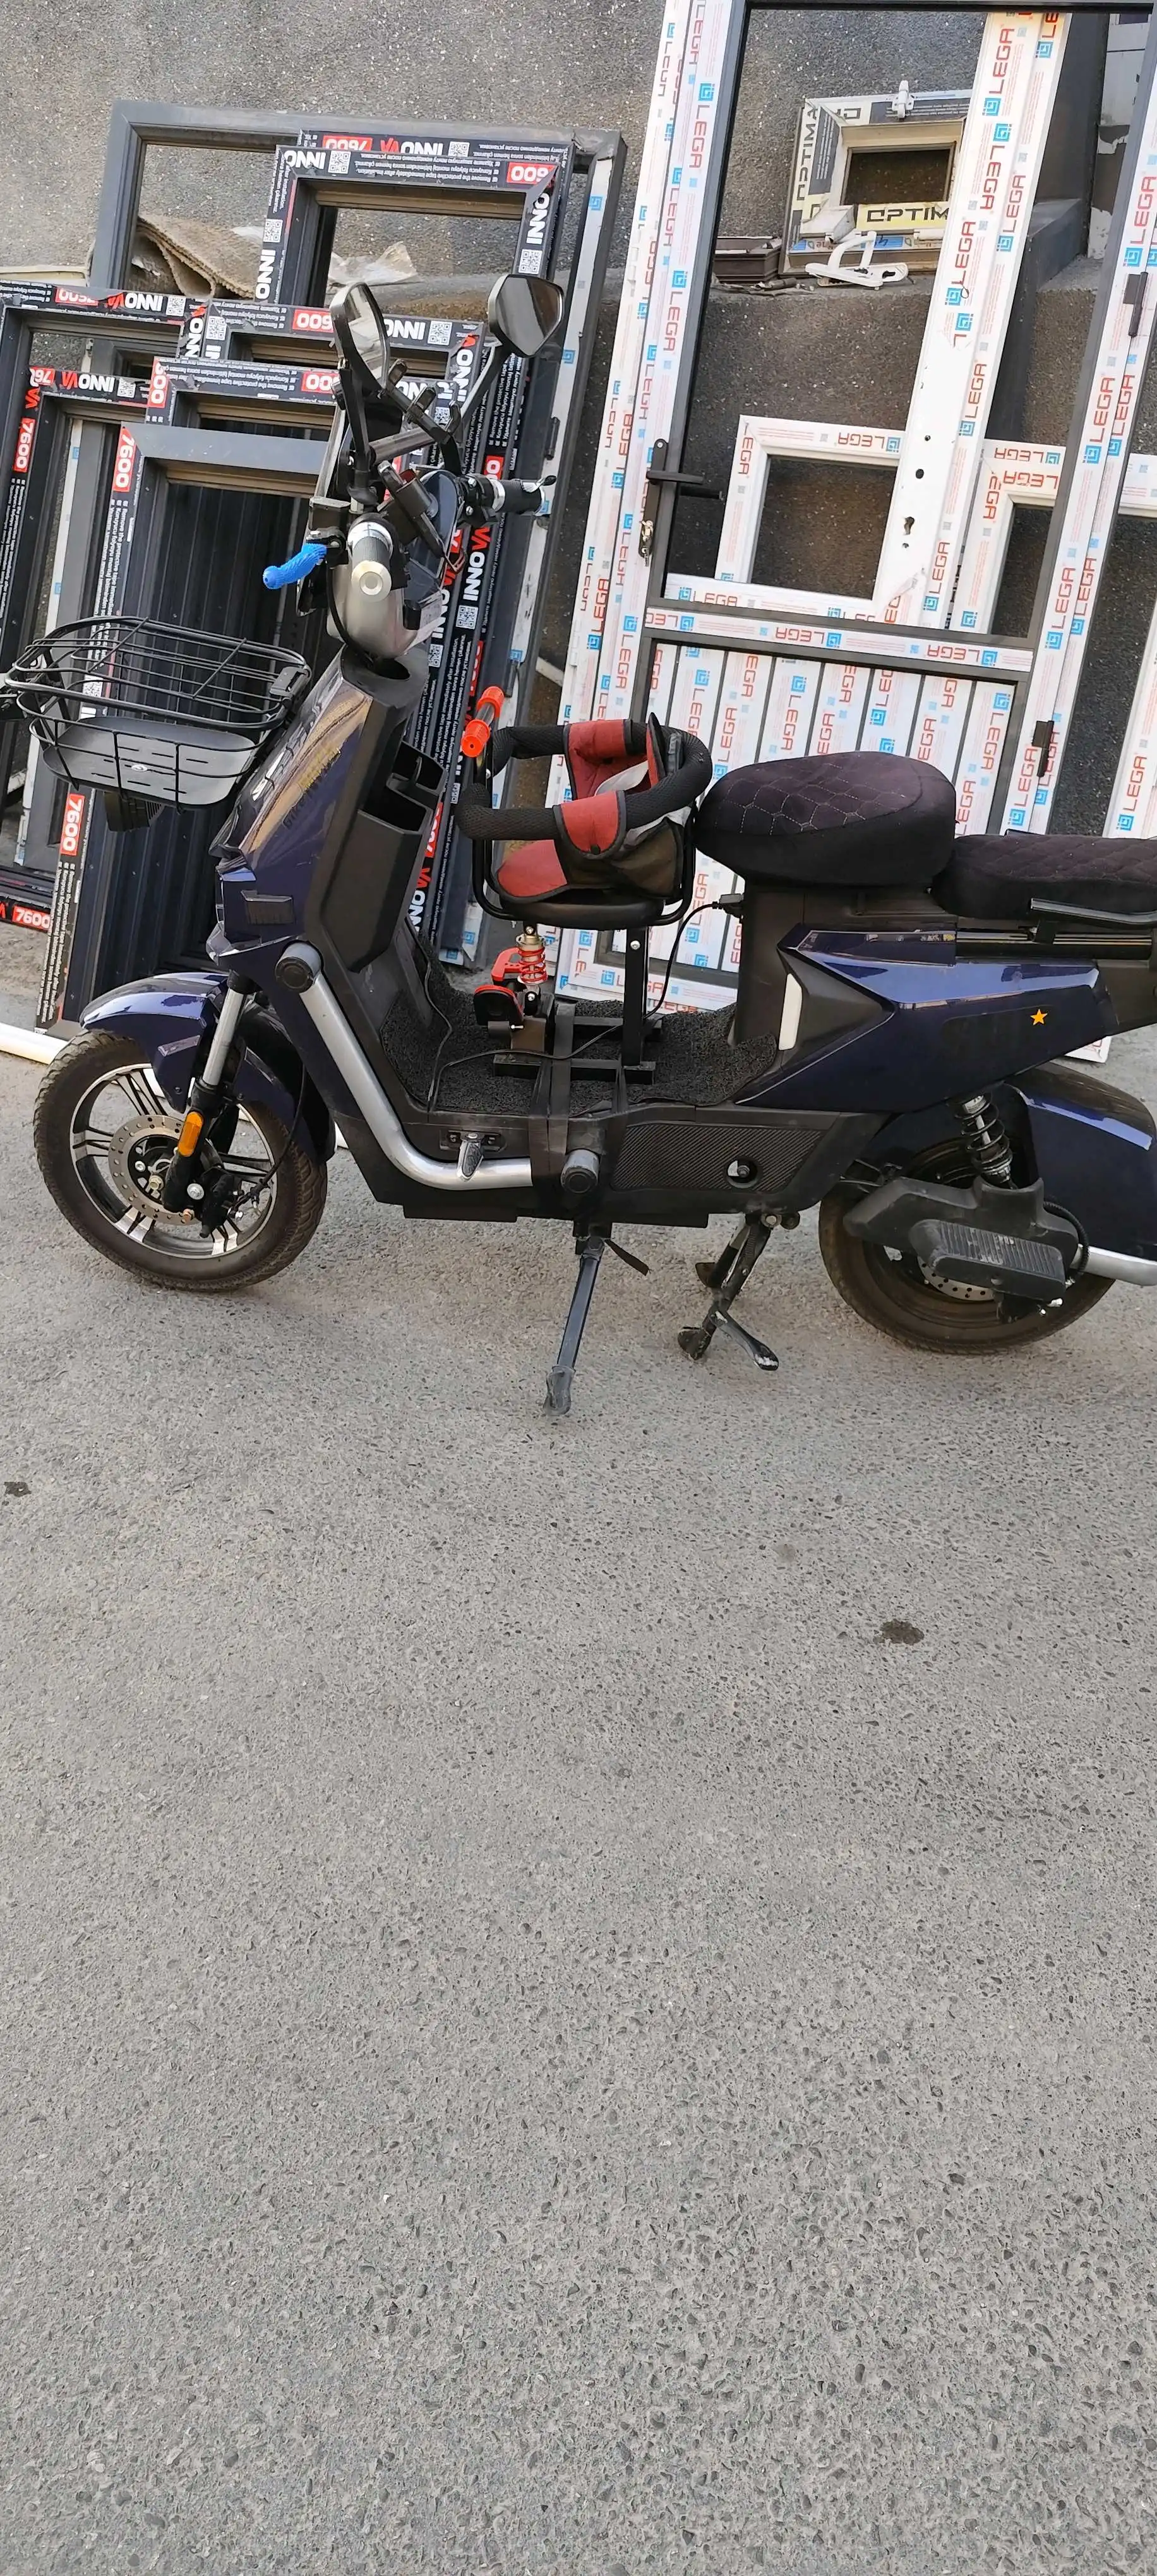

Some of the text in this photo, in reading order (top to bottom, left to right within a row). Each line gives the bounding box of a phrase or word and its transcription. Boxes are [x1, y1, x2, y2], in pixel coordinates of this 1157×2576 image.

[989, 28, 1015, 94] LEGA
[689, 105, 710, 168] LEGA
[980, 145, 1005, 210] LEGA
[1002, 175, 1026, 233] LEGA
[1130, 176, 1157, 244] LEGA
[951, 221, 976, 285] LEGA
[663, 292, 682, 351] LEGA
[488, 363, 510, 438] Remove the protective tape
[965, 363, 987, 419] LEGA
[1090, 377, 1115, 443] LEGA
[16, 422, 34, 468] 7600
[116, 434, 135, 488] 7600
[838, 432, 885, 450] LEGA
[994, 447, 1044, 463] LEGA
[1004, 470, 1059, 490] LEGA
[463, 527, 491, 601] INNOVA
[929, 542, 950, 595] LEGA
[1052, 568, 1076, 629] LEGA
[616, 635, 633, 689] LEGA
[776, 627, 825, 645] LEGA
[927, 645, 980, 662] LEGA
[438, 713, 447, 726] tape
[440, 680, 453, 713] immediately
[781, 695, 801, 750] LEGA
[433, 725, 445, 753] protective
[718, 707, 738, 763] LEGA
[981, 712, 1004, 770] LEGA
[1014, 748, 1038, 807] LEGA
[1123, 756, 1147, 811] LEGA
[62, 798, 82, 851] 7600
[15, 909, 51, 929] 7600
